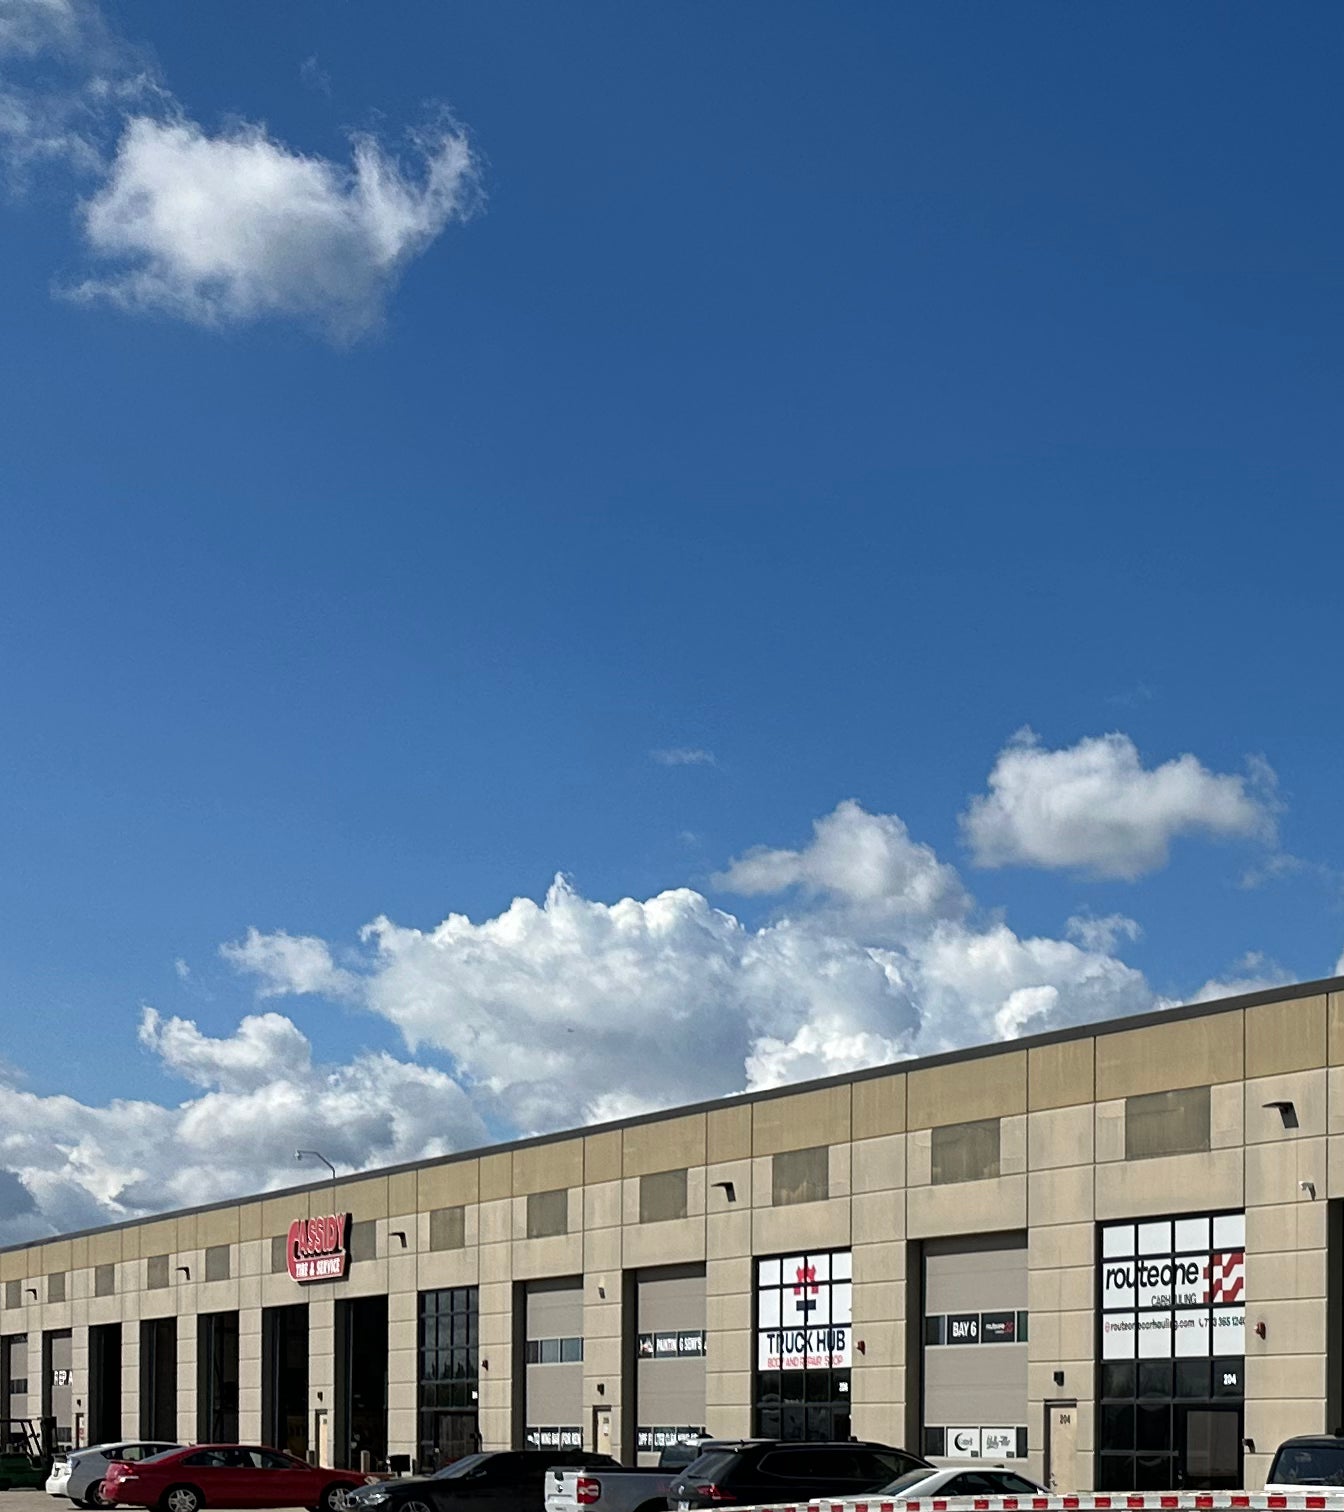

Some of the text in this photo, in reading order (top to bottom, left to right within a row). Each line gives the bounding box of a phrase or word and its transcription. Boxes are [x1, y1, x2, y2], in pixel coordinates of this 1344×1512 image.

[287, 1212, 346, 1262] CASSIDY
[1106, 1260, 1199, 1290] routeone
[767, 1330, 845, 1354] TRUCK HUB
[953, 1321, 977, 1337] BAY 6
